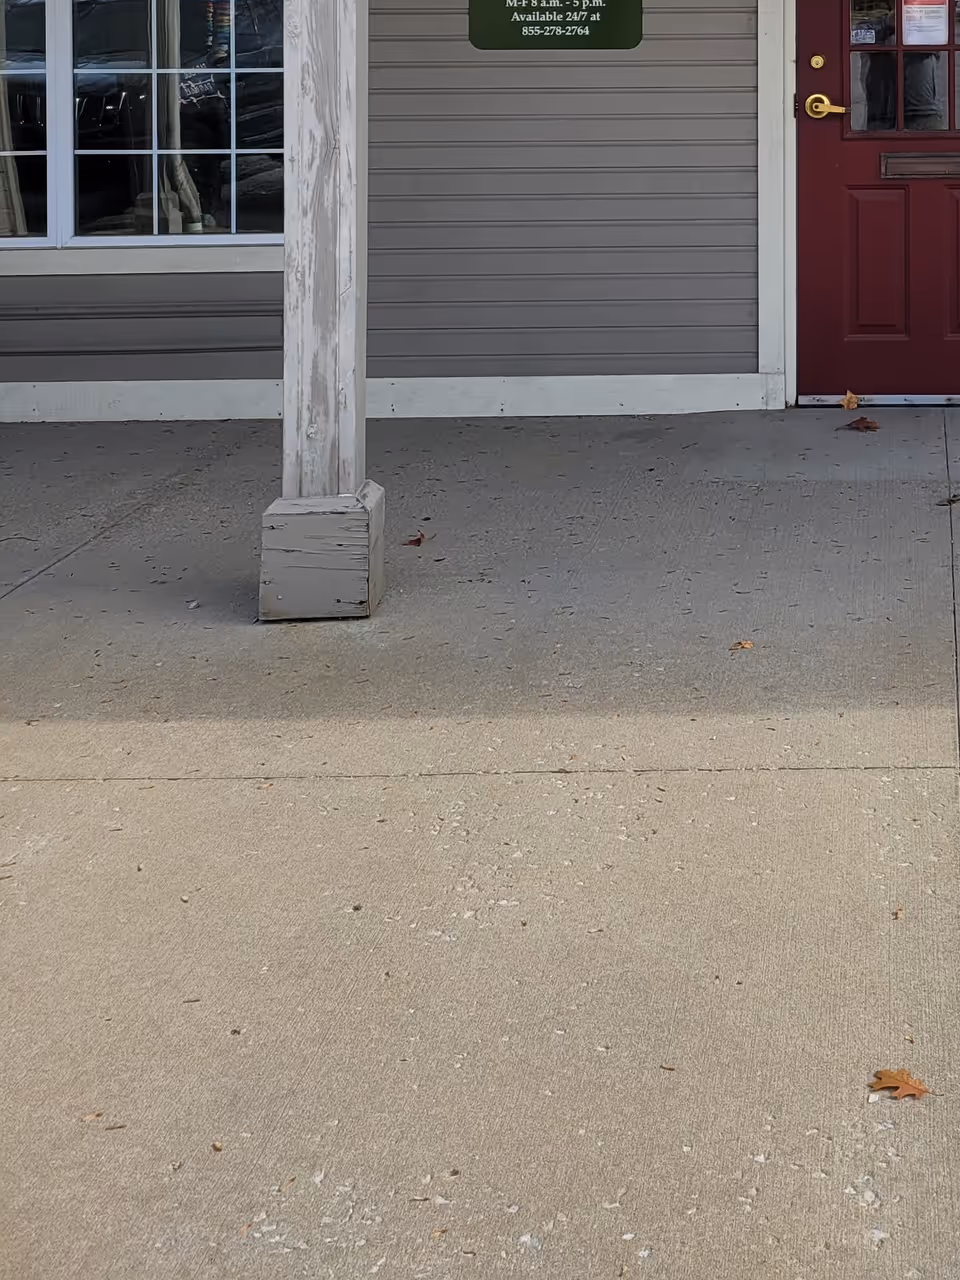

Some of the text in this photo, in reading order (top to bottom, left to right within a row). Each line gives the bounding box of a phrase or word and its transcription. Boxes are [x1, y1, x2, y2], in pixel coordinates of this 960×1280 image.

[540, 0, 563, 7] a.m.
[582, 0, 606, 9] p.m.
[511, 11, 601, 21] Available 24/7 at
[522, 26, 590, 36] 855-278-2764
